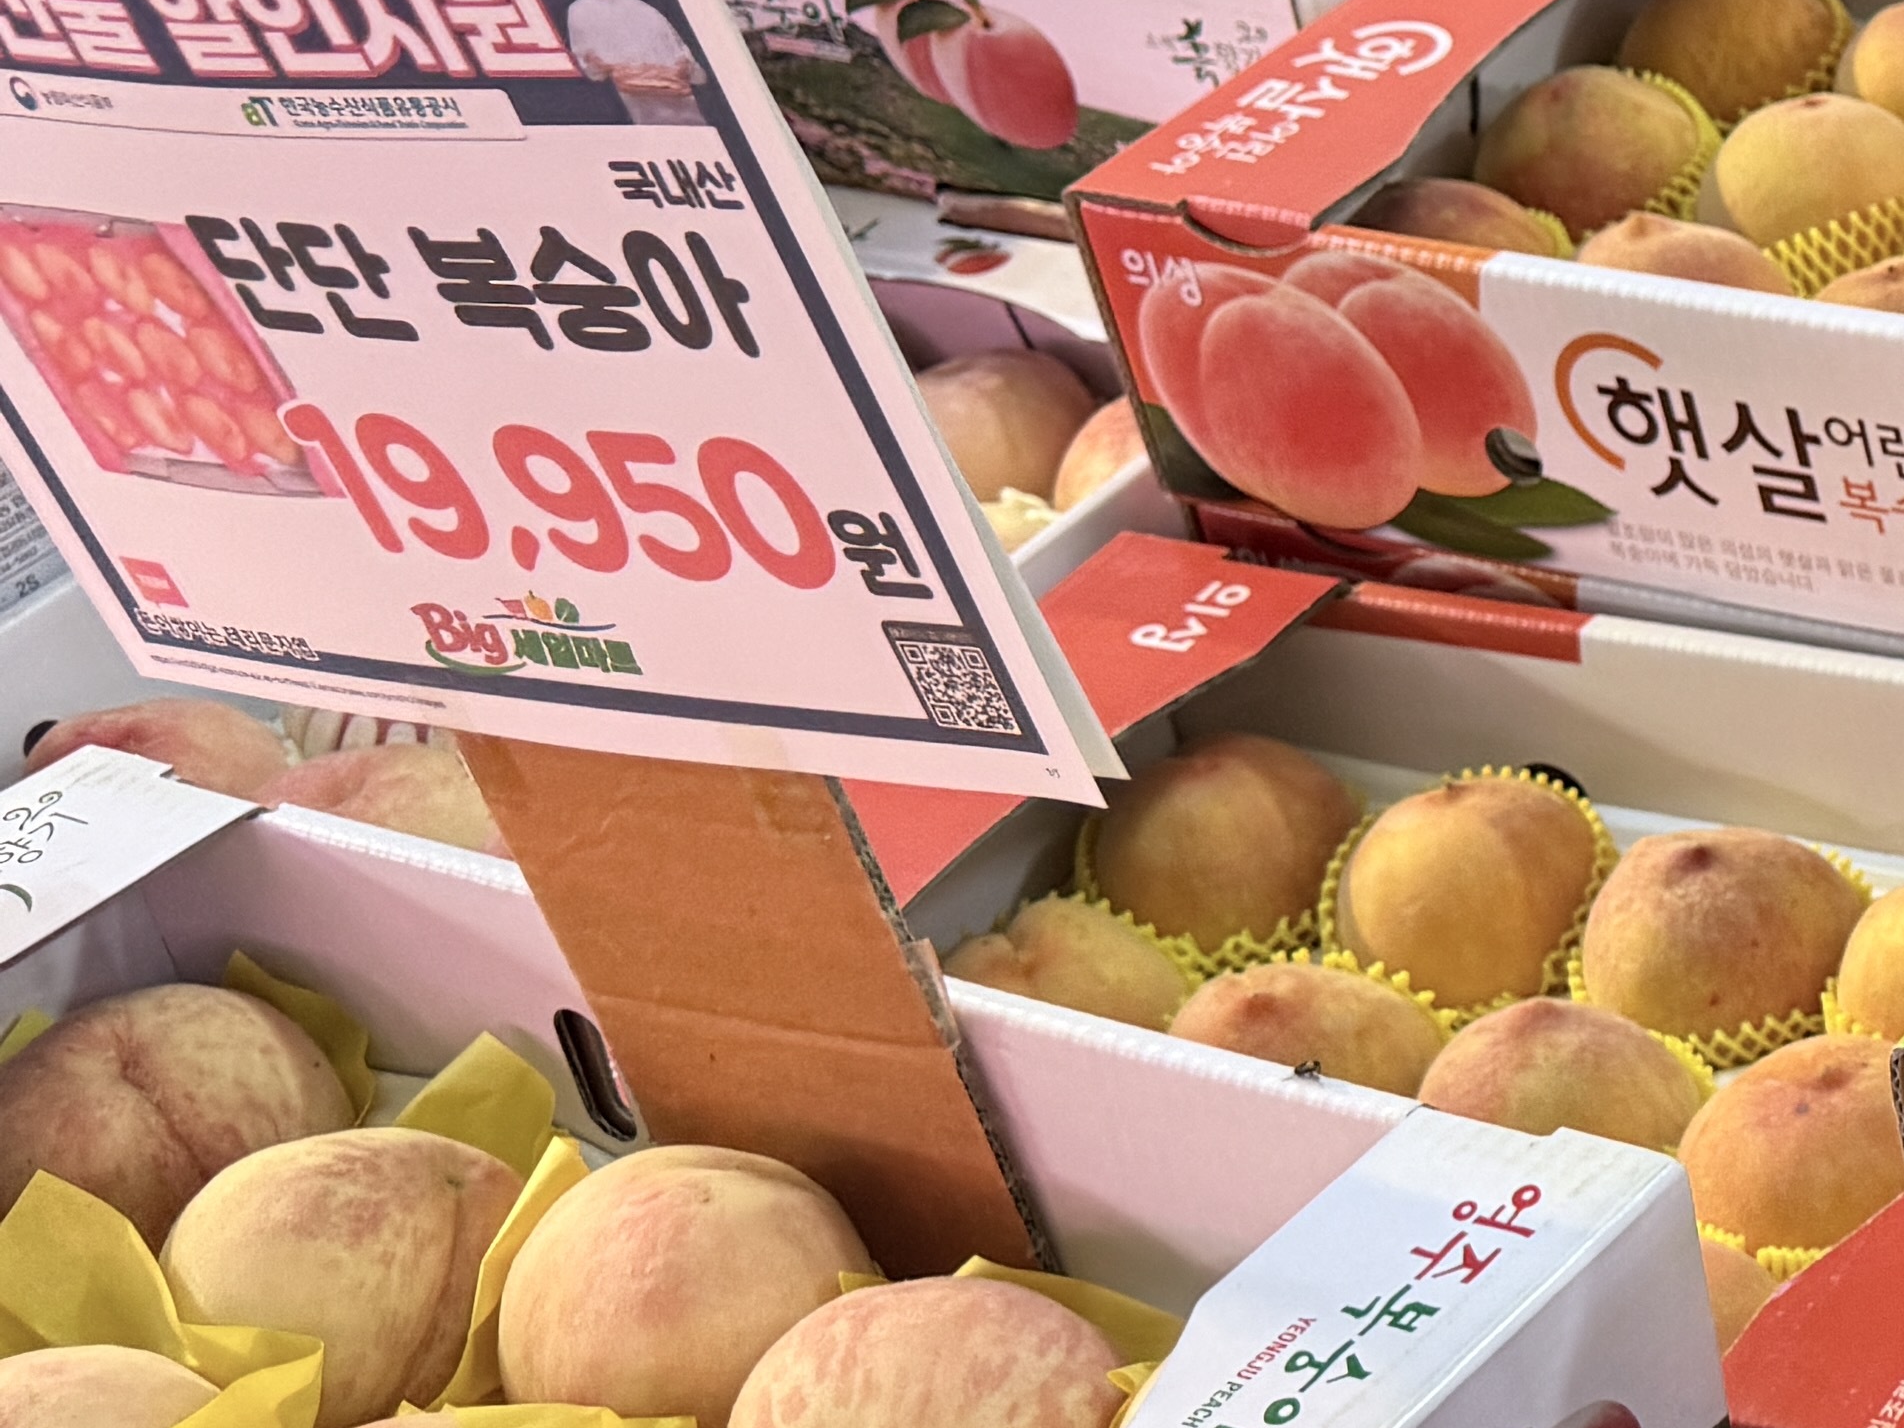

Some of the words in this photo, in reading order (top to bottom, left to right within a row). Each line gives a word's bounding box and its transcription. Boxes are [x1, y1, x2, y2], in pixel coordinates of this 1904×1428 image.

[1238, 37, 1415, 120] 햇살
[608, 159, 739, 211] 국내산
[187, 213, 420, 343] 단단
[406, 222, 761, 361] 복숭아
[1121, 244, 1201, 308] 의성
[1597, 373, 1829, 527] 햇살
[286, 402, 836, 589] 19,950
[831, 510, 934, 600] 원
[409, 602, 505, 666] Big
[1132, 576, 1252, 656] 의성
[1412, 1181, 1544, 1284] 영주
[1237, 1312, 1320, 1385] YEONGJU
